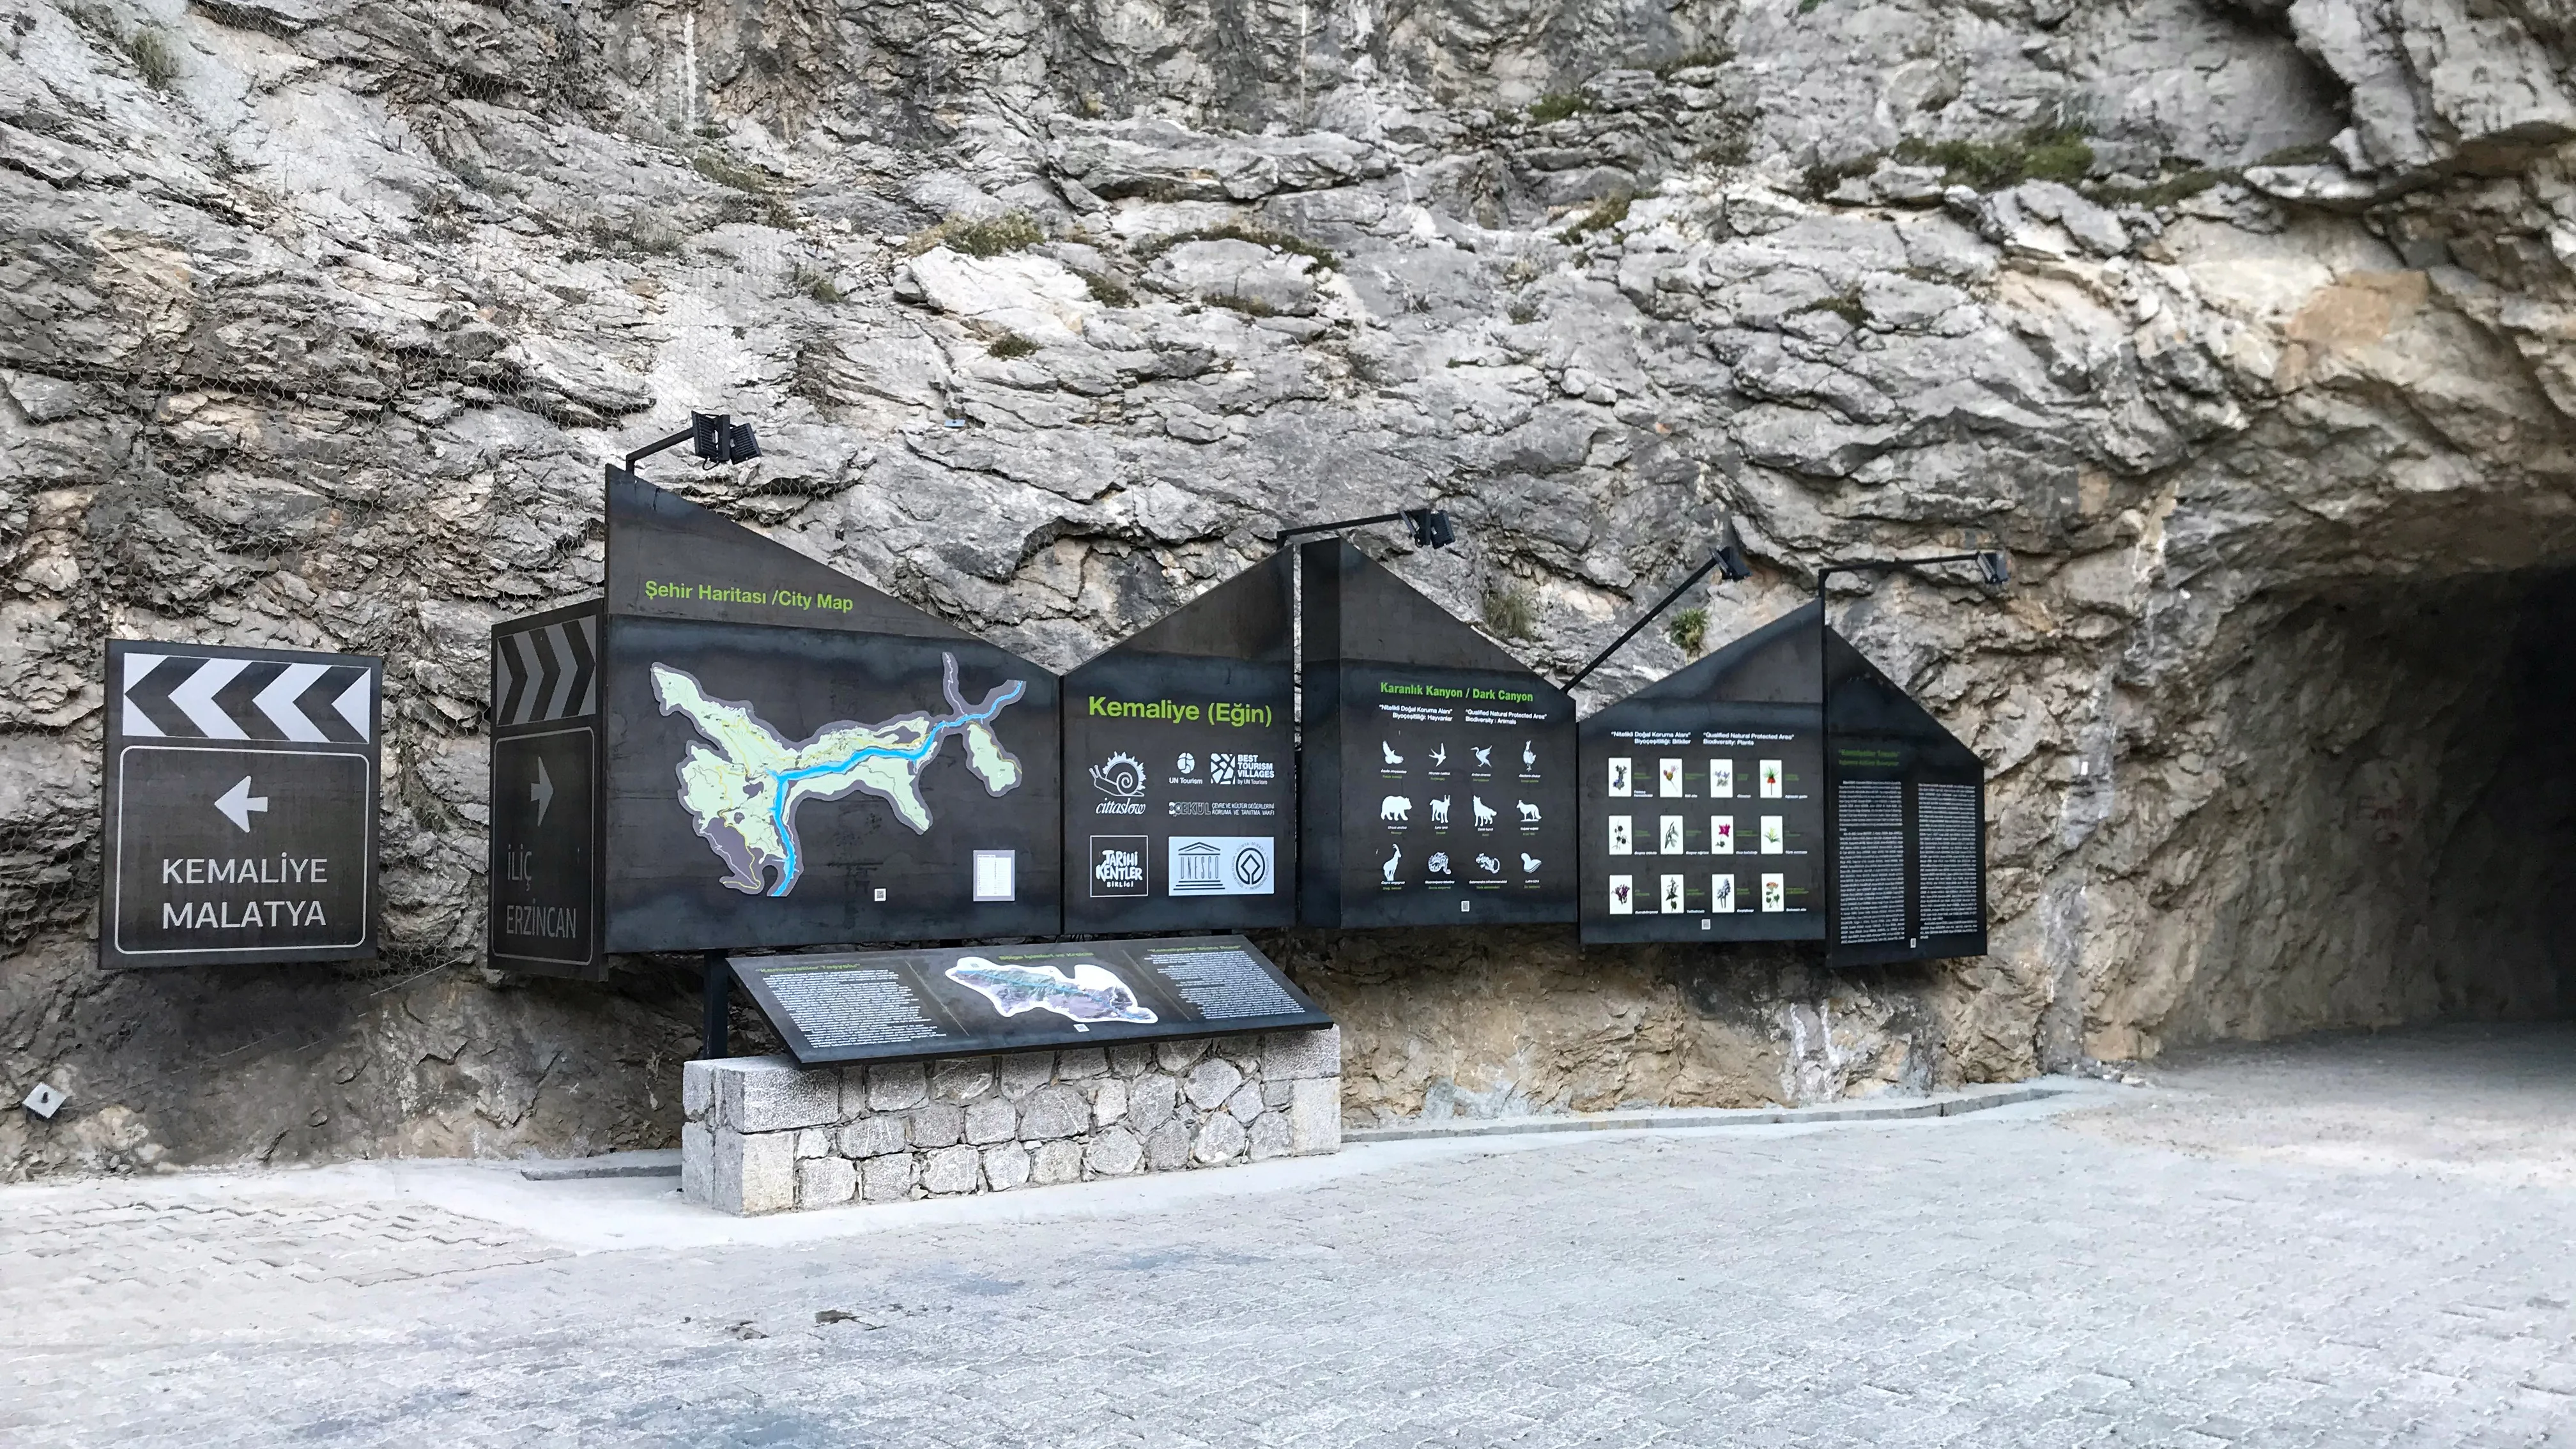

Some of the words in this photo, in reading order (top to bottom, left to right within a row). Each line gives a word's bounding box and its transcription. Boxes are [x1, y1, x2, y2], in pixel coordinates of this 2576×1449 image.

[645, 579, 693, 600] Şehir
[698, 584, 767, 604] Haritası
[816, 593, 854, 613] Map
[1380, 682, 1423, 695] Karanlık
[1425, 686, 1463, 698] Kanyon
[1465, 687, 1470, 698] /
[1473, 688, 1496, 700] Dark
[1498, 690, 1533, 703] Canyon
[1089, 696, 1200, 724] Kemaliye
[1208, 702, 1272, 727] (Eğin)
[1237, 754, 1259, 762] BEST
[1237, 762, 1273, 770] TOURISM
[1237, 770, 1275, 778] VILLAGES
[1095, 797, 1146, 815] cittaslow
[162, 852, 328, 884] KEMALİYE
[507, 843, 532, 892] İLİÇ
[1096, 860, 1143, 882] KENTLER
[1180, 855, 1220, 880] UNESCO
[162, 900, 326, 929] MALATYA
[507, 898, 577, 939] ERZİNCAN
